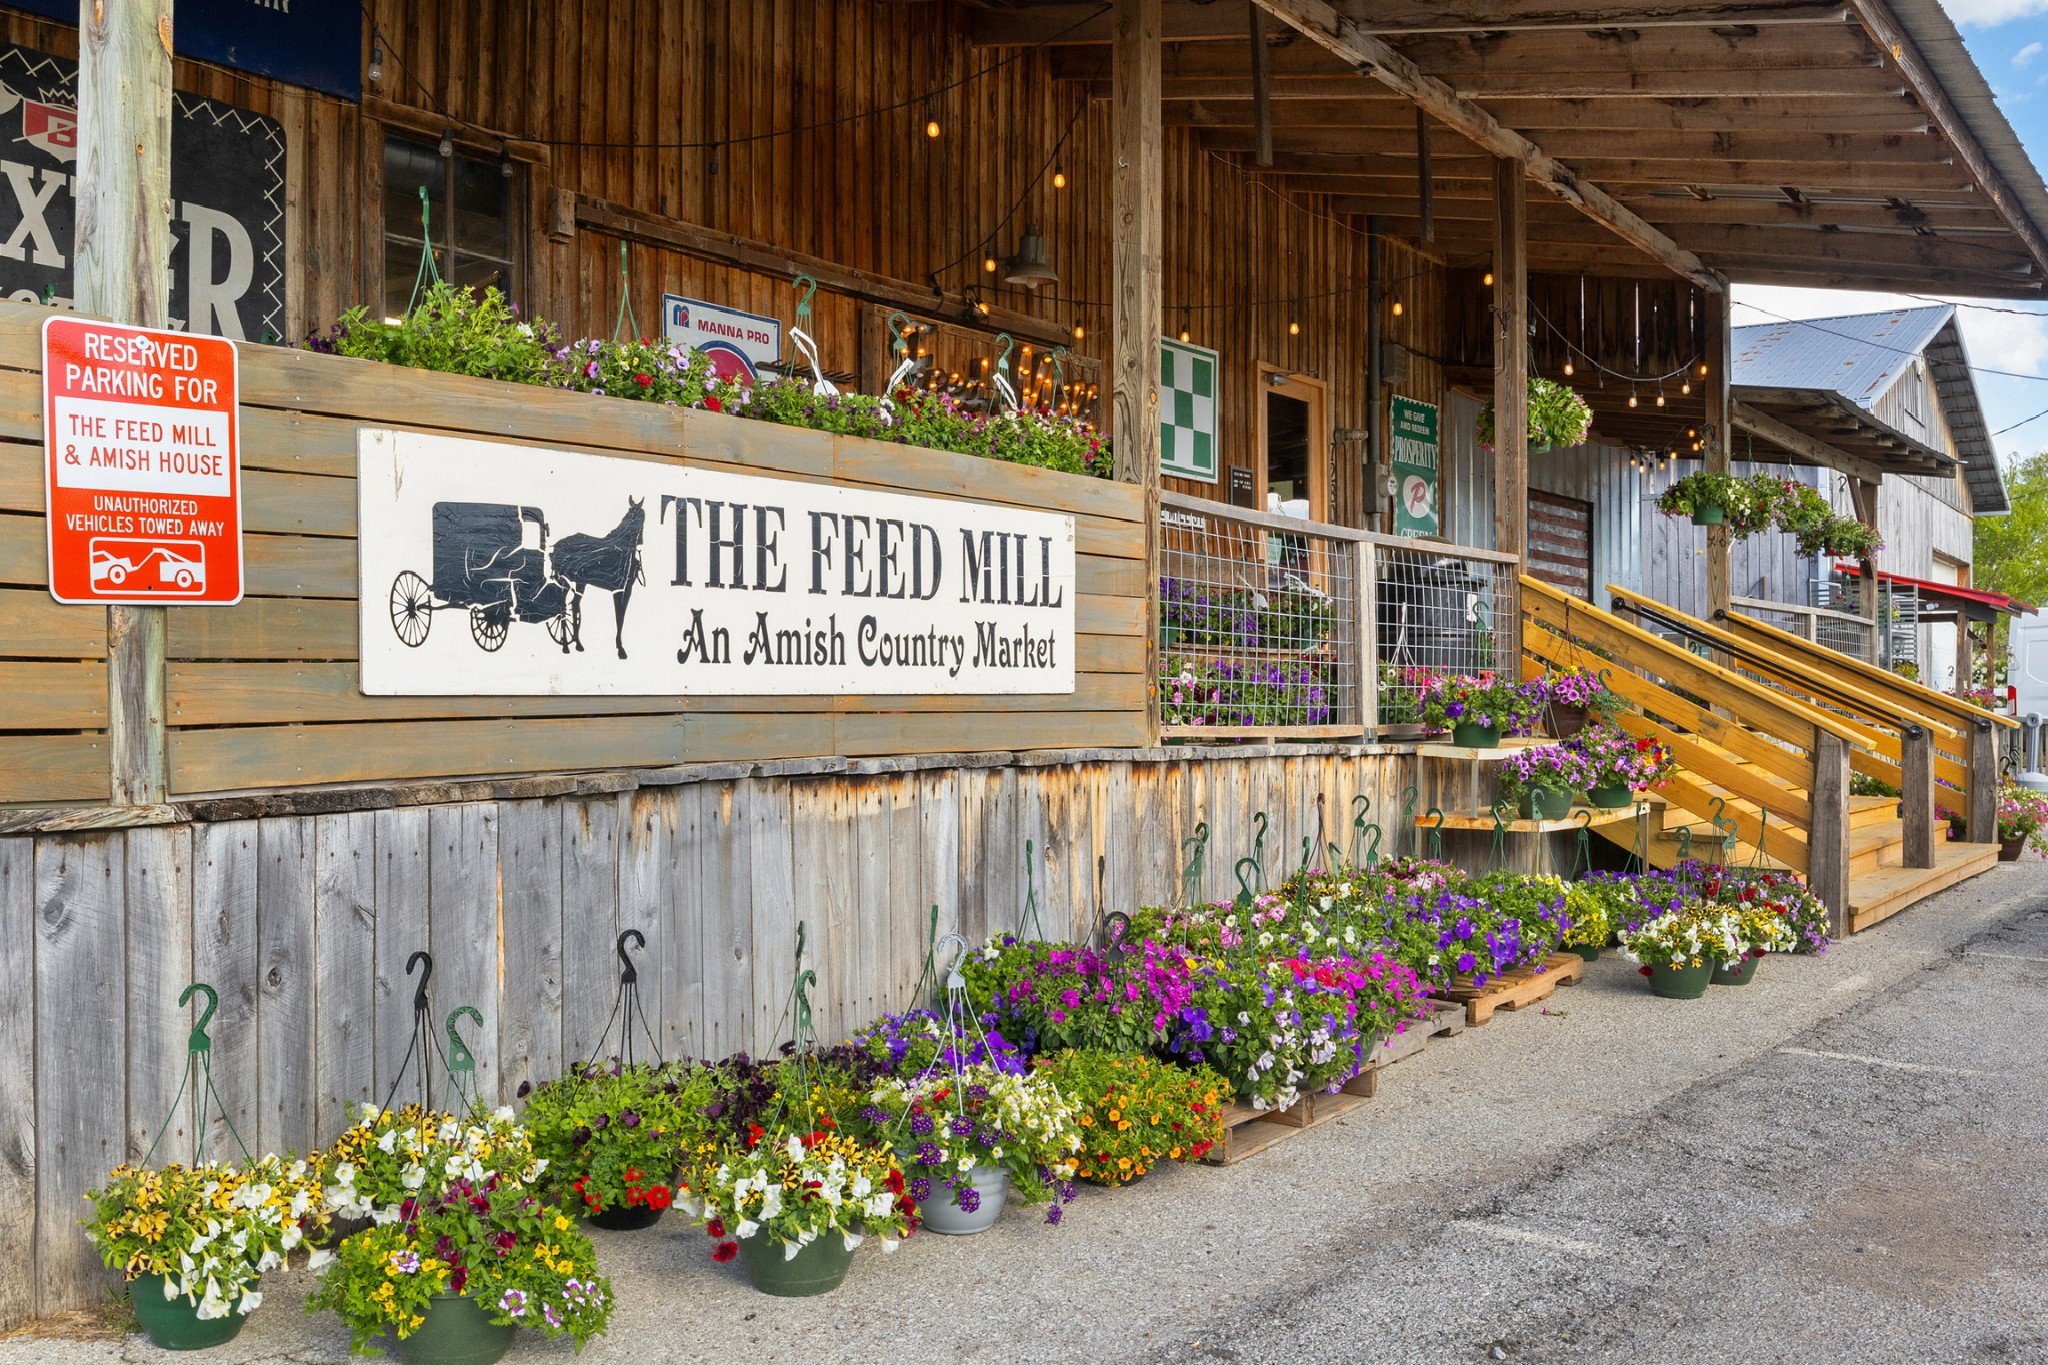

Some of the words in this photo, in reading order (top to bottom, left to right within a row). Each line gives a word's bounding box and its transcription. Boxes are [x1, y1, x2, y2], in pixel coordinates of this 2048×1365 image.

[697, 319, 744, 340] MANNA
[747, 330, 770, 345] PRO
[84, 332, 198, 371] RESERVED
[66, 363, 163, 399] PARKING
[174, 376, 218, 404] FOR
[68, 414, 106, 439] THE
[115, 419, 163, 443] FEED
[172, 424, 217, 447] MILL
[1400, 420, 1411, 431] AND
[1411, 423, 1430, 436] REDEEM
[1403, 409, 1412, 421] WE
[1413, 411, 1425, 424] GIVE
[64, 444, 81, 466] &
[89, 447, 150, 472] AMISH
[159, 452, 223, 476] HOUSE
[1394, 435, 1437, 471] PROSPERITY
[94, 495, 198, 516] UNAUTHORIZED
[66, 513, 134, 533] VEHICLES
[138, 517, 183, 535] TOWED
[189, 521, 224, 537] AWAY
[660, 494, 787, 593] THE
[807, 510, 943, 601] FEED
[959, 527, 1063, 608] MILL
[676, 608, 731, 665] An
[743, 611, 847, 667] Amish
[857, 614, 965, 678] Country
[972, 620, 1057, 669] Market
